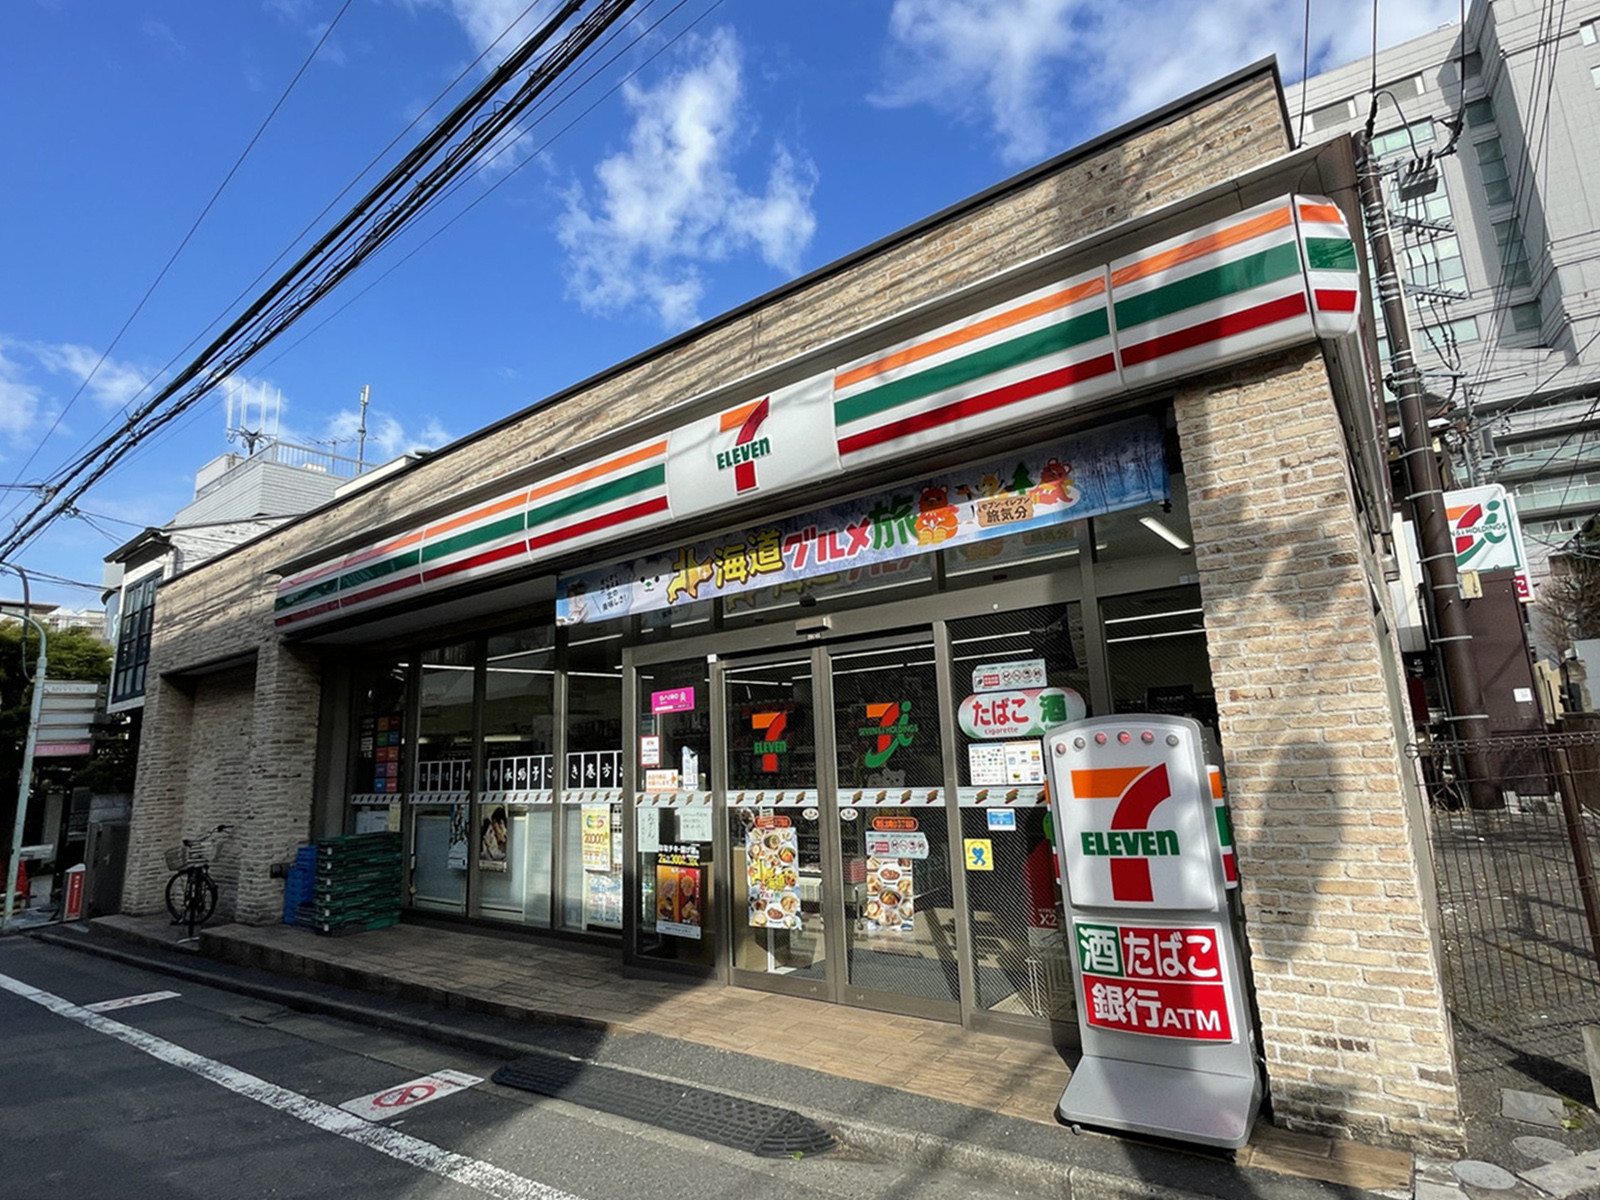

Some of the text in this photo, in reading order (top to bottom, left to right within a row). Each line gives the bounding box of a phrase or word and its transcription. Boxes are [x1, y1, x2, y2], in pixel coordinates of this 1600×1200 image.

[986, 505, 1028, 523] 旅気分
[972, 697, 1030, 727] たばこ
[1039, 693, 1067, 723] 酒
[984, 726, 1019, 736] cigarette
[1079, 926, 1218, 978] 酒 たばこ
